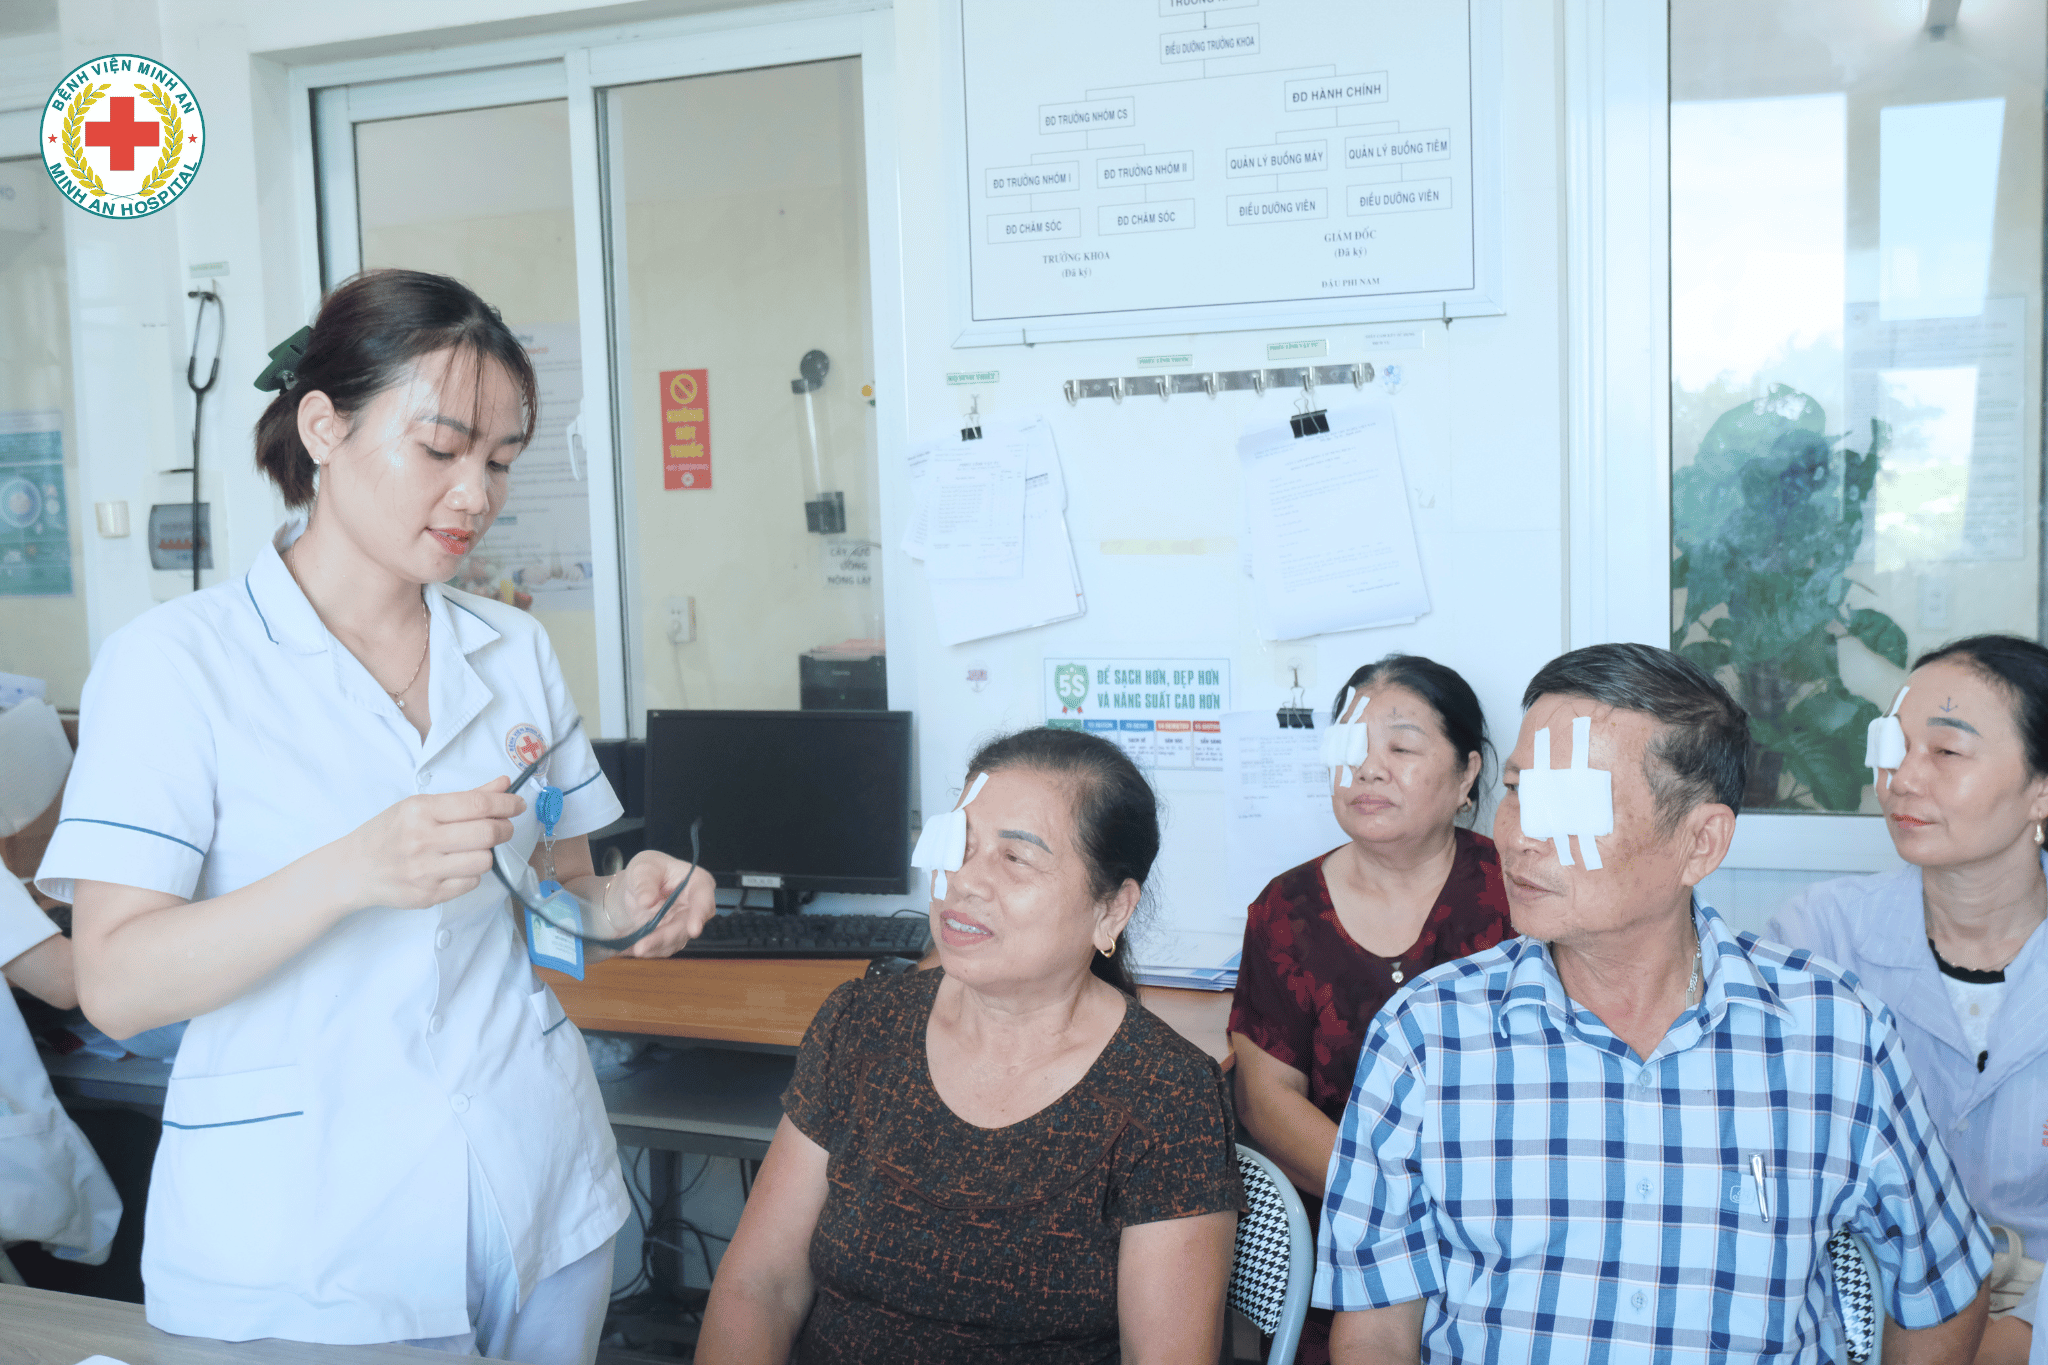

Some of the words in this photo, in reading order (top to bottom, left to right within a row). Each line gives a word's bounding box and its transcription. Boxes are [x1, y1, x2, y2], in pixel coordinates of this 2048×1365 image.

[1236, 35, 1255, 48] KHOA
[1292, 91, 1308, 103] ĐD
[1311, 85, 1343, 101] HÀNH
[1346, 83, 1382, 98] CHÍNH
[1045, 115, 1056, 127] ĐD
[1092, 108, 1115, 122] NHÓM
[1117, 109, 1128, 120] CS
[1348, 144, 1374, 160] QUẢN
[1376, 143, 1388, 157] LÝ
[1426, 138, 1448, 153] TIÊM
[1230, 154, 1255, 170] QUẢN
[1257, 153, 1268, 167] LÝ
[1304, 149, 1324, 163] MÁY
[1104, 169, 1116, 180] ĐD
[1155, 161, 1180, 175] NHÓM
[1182, 162, 1188, 172] II
[993, 179, 1004, 189] ĐD
[1042, 171, 1067, 185] NHÓM
[1418, 188, 1440, 201] VIÊN
[1295, 198, 1316, 212] VIÊN
[1006, 224, 1017, 235] ĐD
[1045, 219, 1063, 232] SÓC
[1117, 215, 1129, 226] ĐD
[1158, 210, 1176, 223] SÓC
[1324, 230, 1352, 243] GIÁM
[1354, 225, 1377, 241] ĐỐC
[1083, 251, 1110, 261] KHOA
[1359, 277, 1380, 285] NAM
[1059, 673, 1085, 698] 5S
[1114, 669, 1142, 688] SẠCH
[1145, 668, 1170, 687] HƠN,
[1173, 670, 1194, 689] ĐẸP
[1198, 668, 1219, 685] HƠN
[1113, 692, 1141, 709] NĂNG
[1145, 690, 1170, 709] SUẤT
[1174, 693, 1195, 709] CAO
[1199, 692, 1221, 709] HƠN
